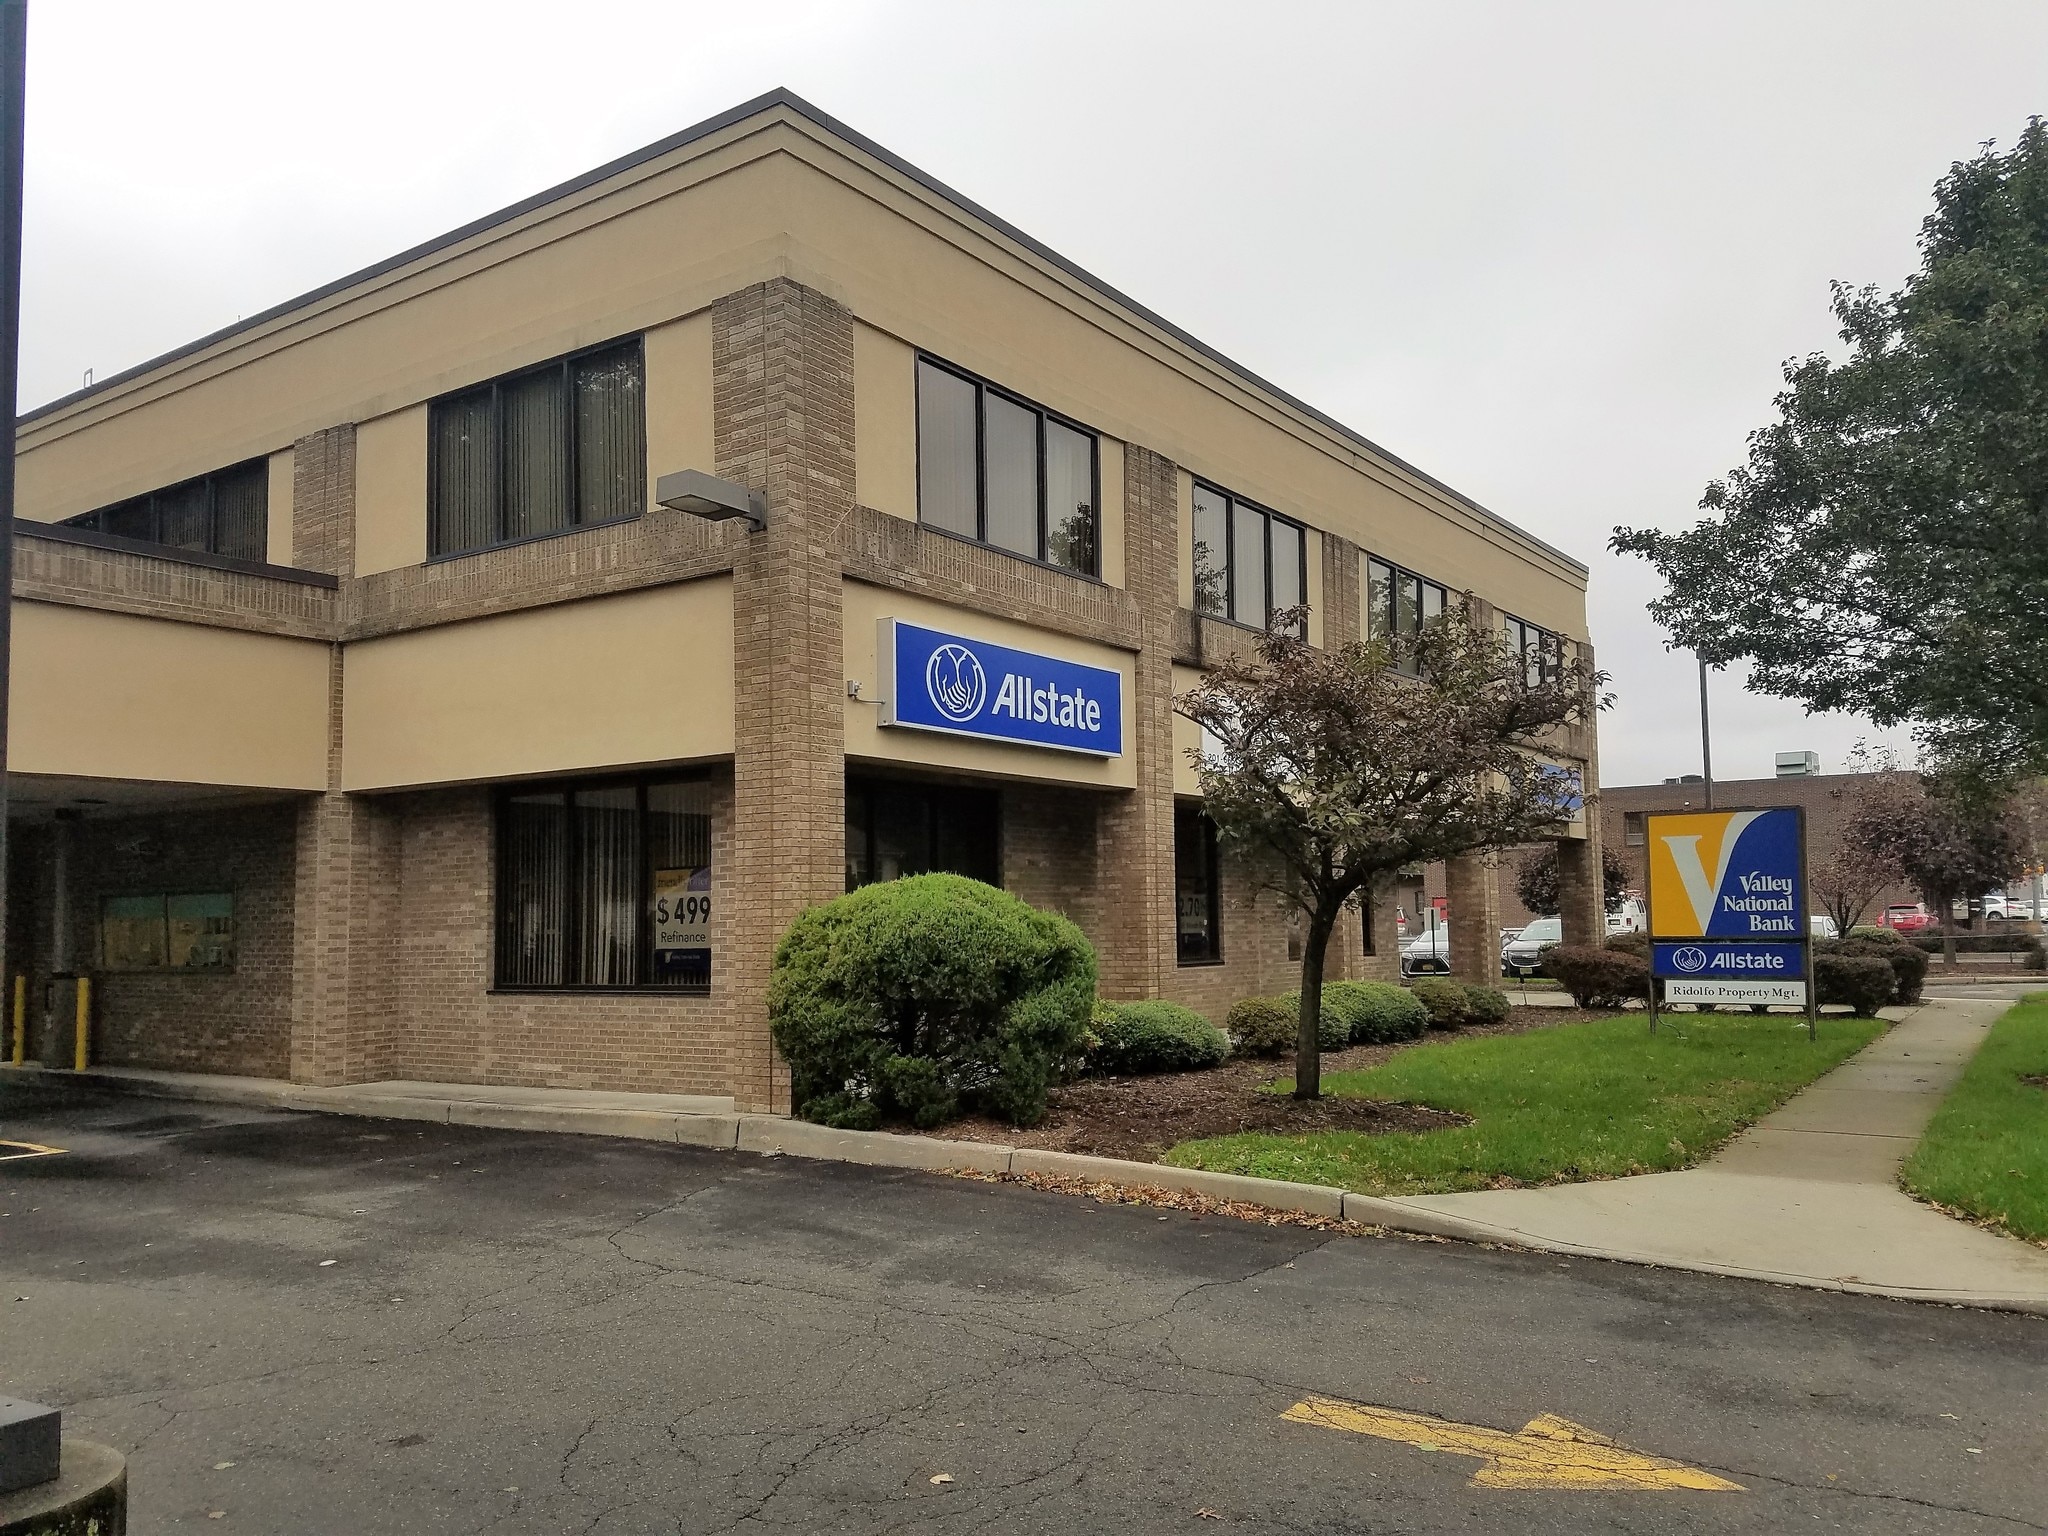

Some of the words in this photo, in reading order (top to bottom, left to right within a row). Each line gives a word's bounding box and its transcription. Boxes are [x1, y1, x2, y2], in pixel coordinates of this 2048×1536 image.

[991, 672, 1101, 732] Allstate
[1739, 871, 1793, 894] Valley
[1723, 895, 1794, 912] National
[1750, 914, 1795, 931] Bank
[660, 930, 706, 943] Refinance
[1710, 952, 1784, 969] Allstate
[1673, 986, 1715, 996] Ridolfo
[1718, 987, 1770, 999] Property
[1772, 988, 1799, 1000] Mgt.
